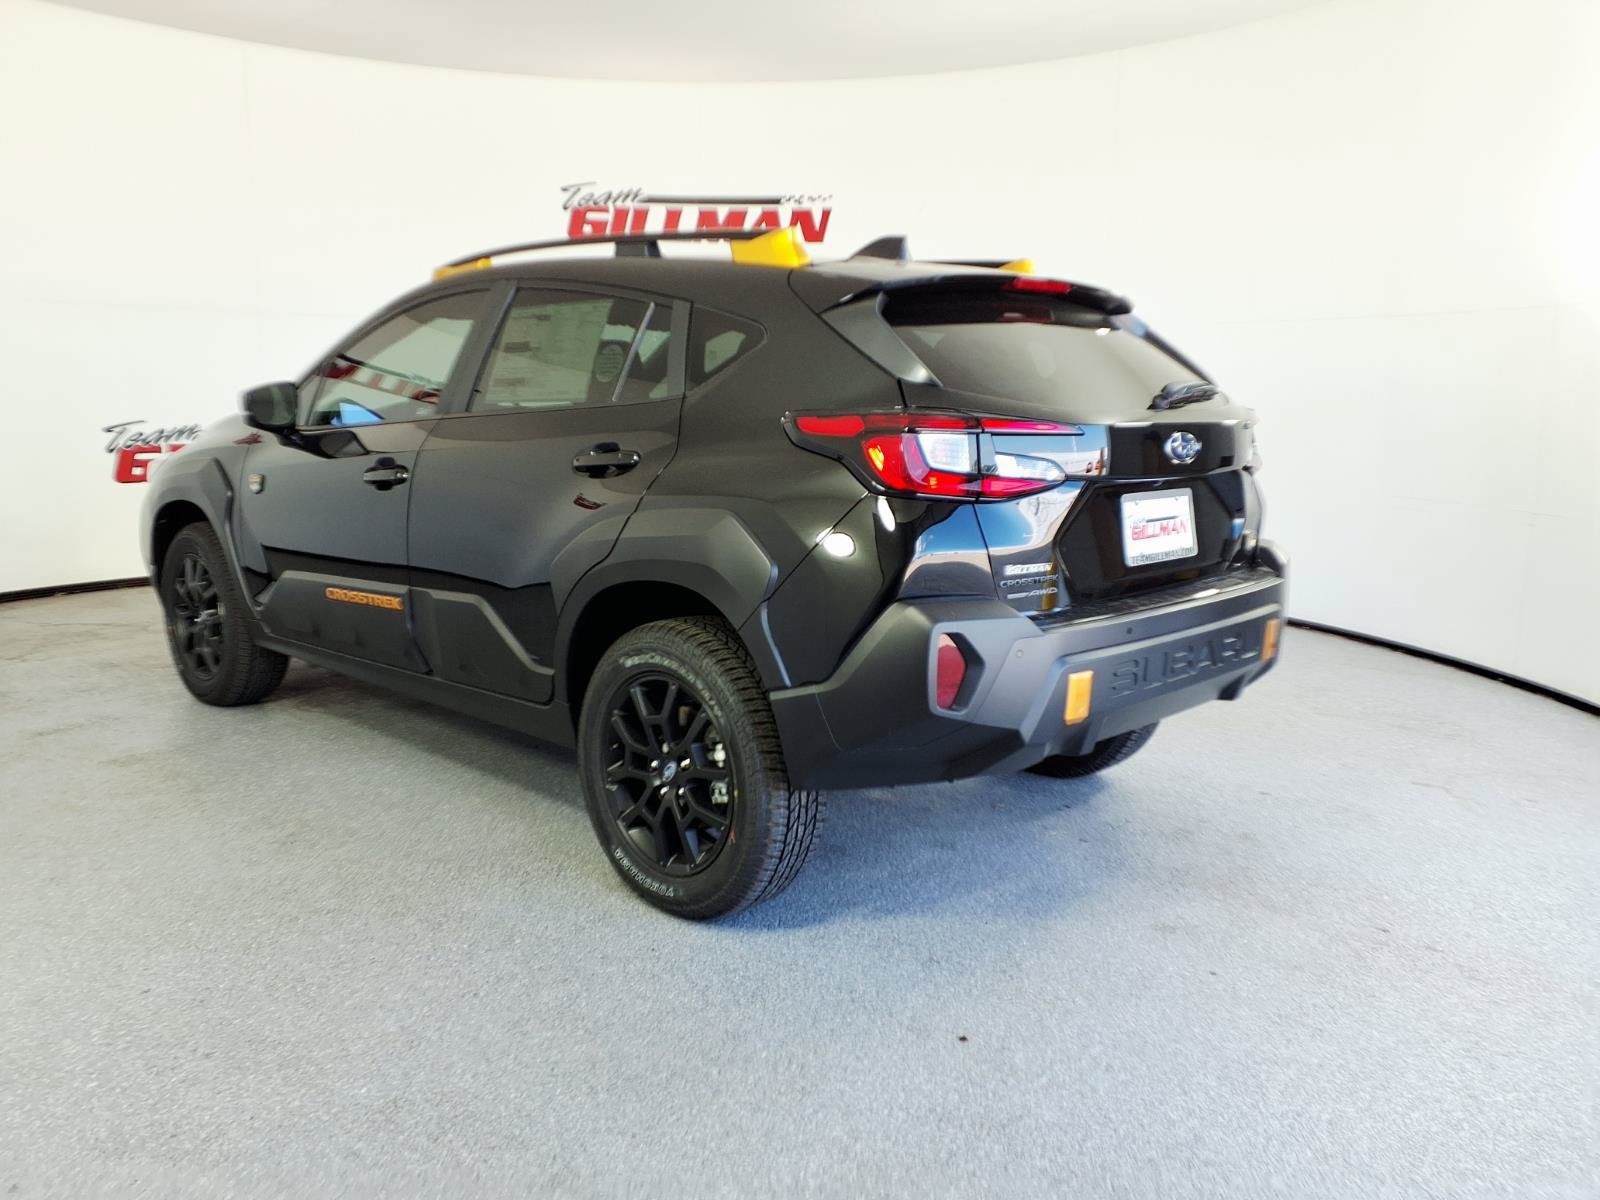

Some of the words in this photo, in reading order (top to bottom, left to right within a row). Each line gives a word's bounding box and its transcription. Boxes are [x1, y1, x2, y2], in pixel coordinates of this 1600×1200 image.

[560, 181, 643, 210] Team
[1000, 575, 1059, 588] CROSSTREK
[325, 587, 404, 610] CROSSTREK
[1029, 587, 1058, 597] AWD
